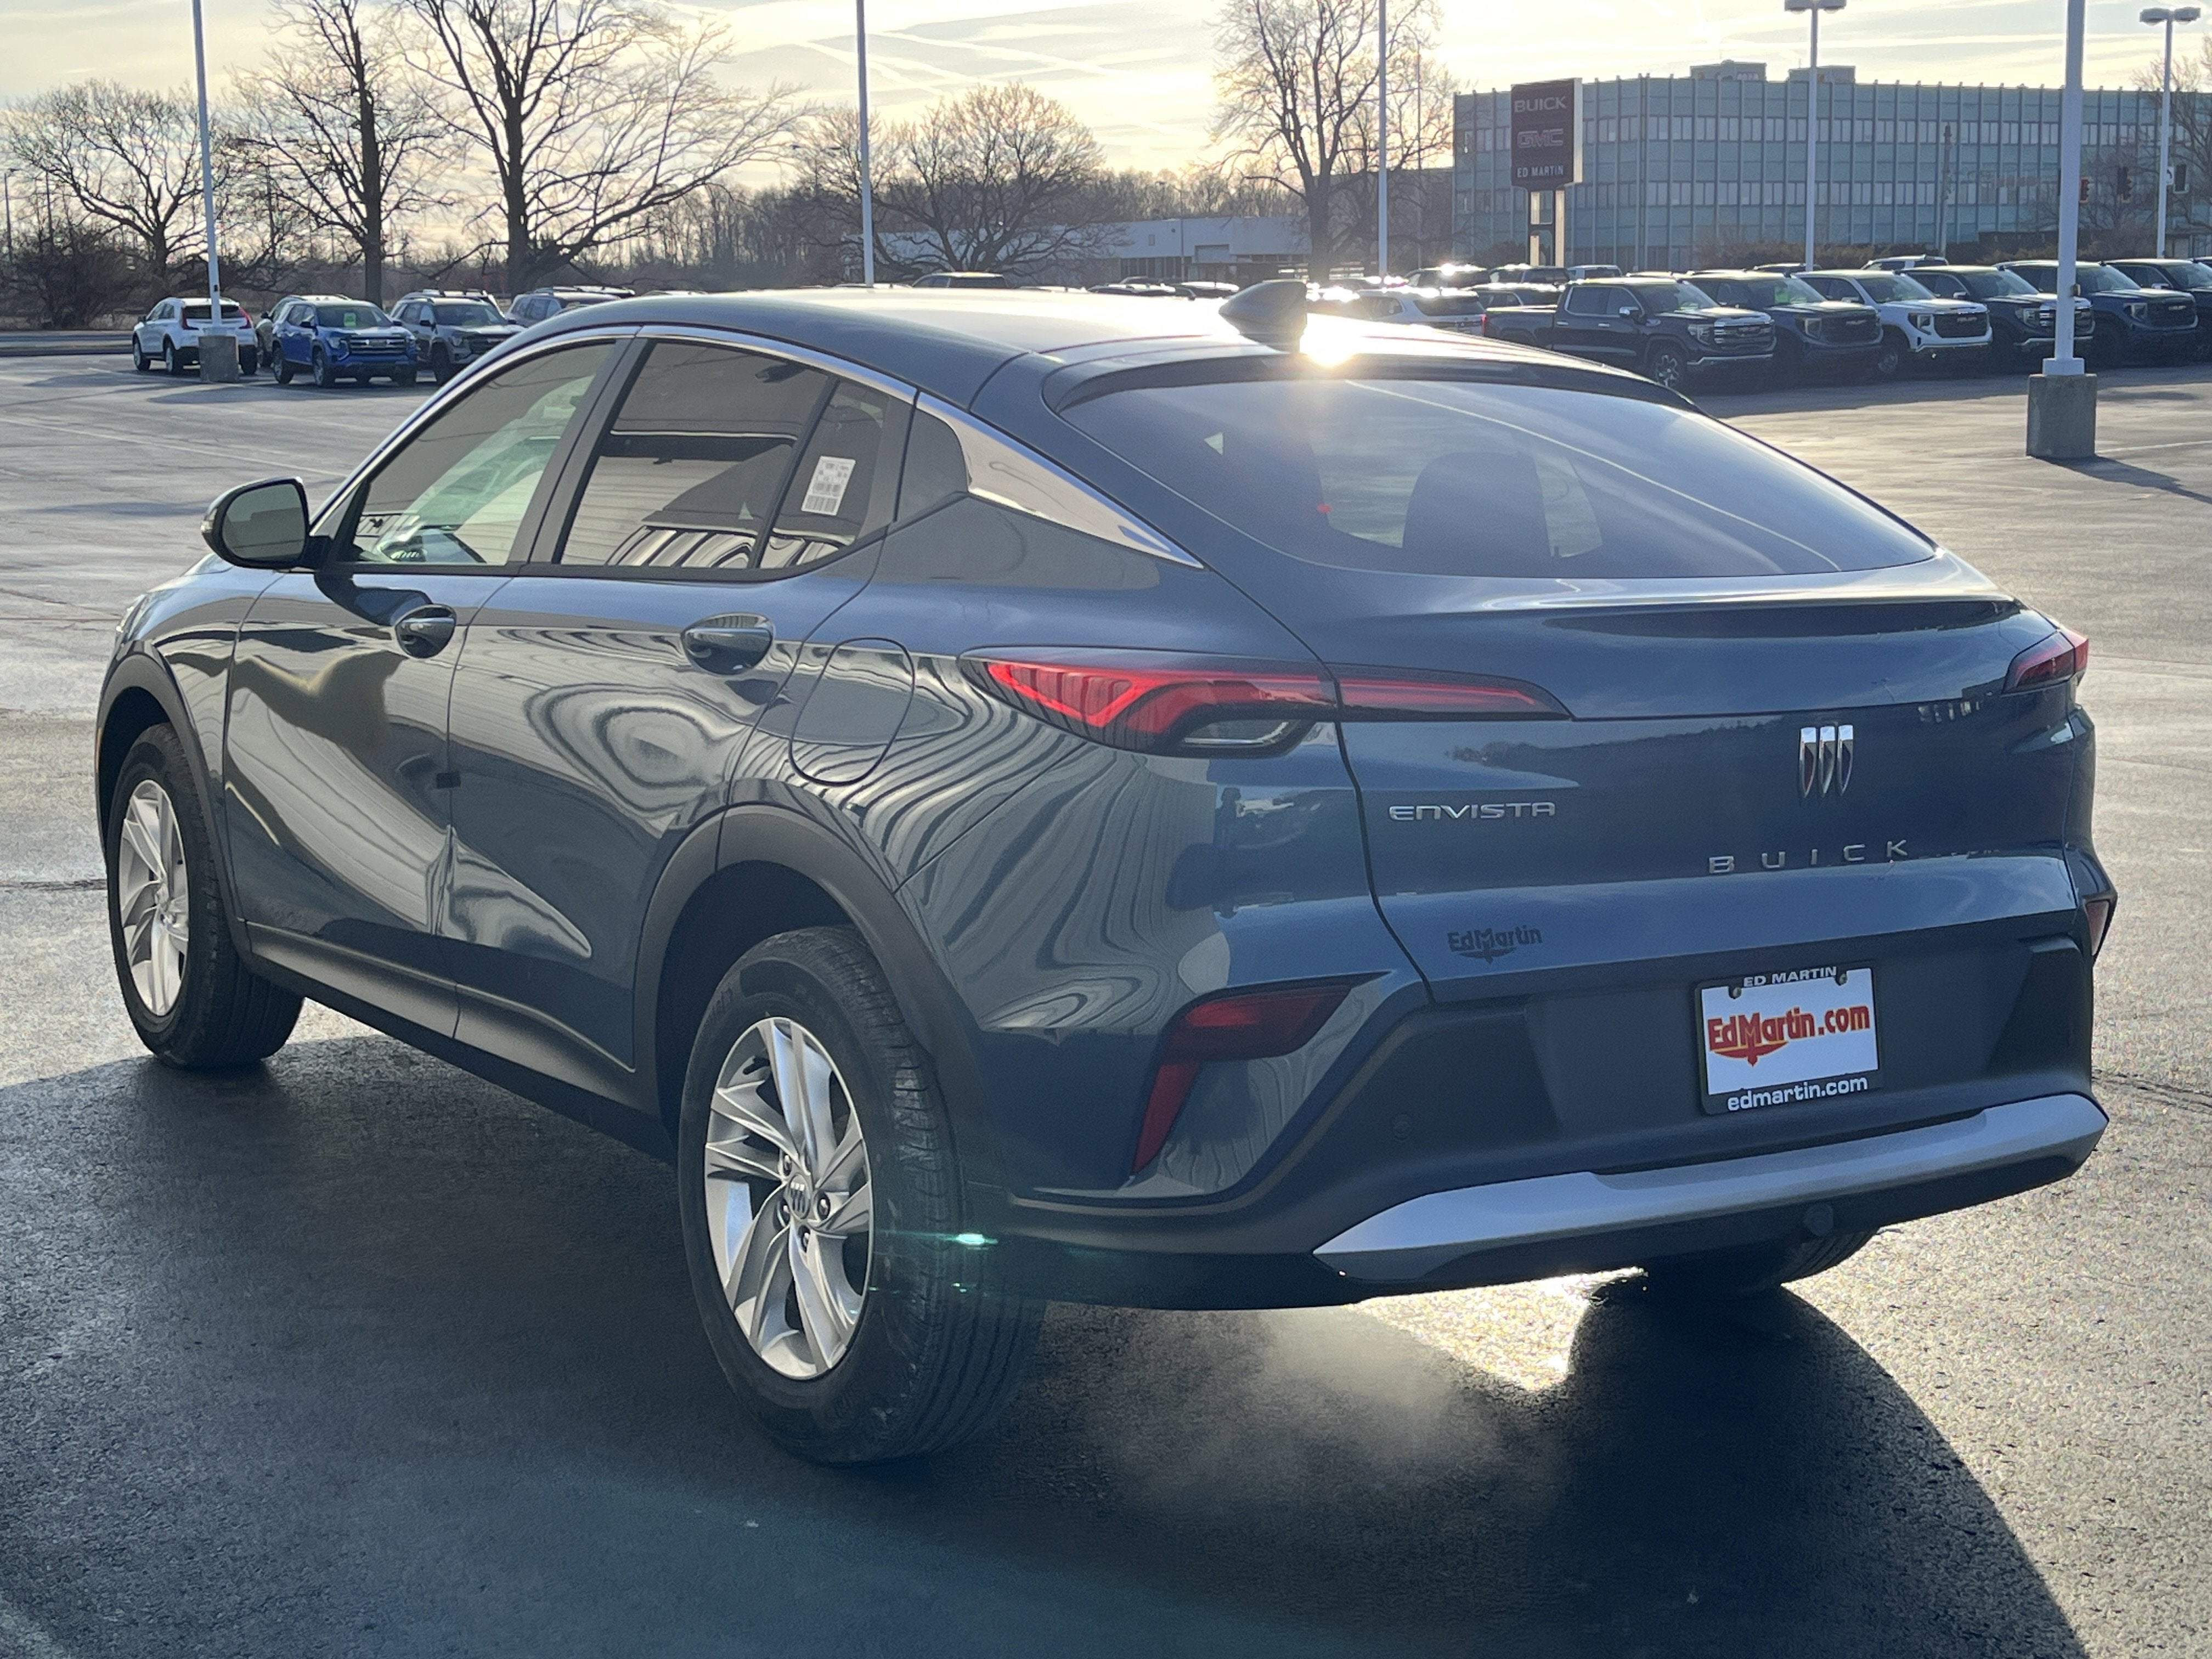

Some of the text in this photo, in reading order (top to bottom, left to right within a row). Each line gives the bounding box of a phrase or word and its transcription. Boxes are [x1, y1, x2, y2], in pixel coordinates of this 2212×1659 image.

[1514, 96, 1567, 112] BUICK
[1517, 128, 1564, 148] GMC
[1517, 165, 1564, 178] ED MARTIN
[1389, 802, 1556, 821] ENVISTA
[1708, 839, 1908, 873] BUICK
[1447, 924, 1543, 953] EdMartin
[1743, 966, 1837, 988] ED MARTIN
[1707, 1005, 1870, 1052] EdMartin.com
[1728, 1076, 1869, 1111] edmartin.com
